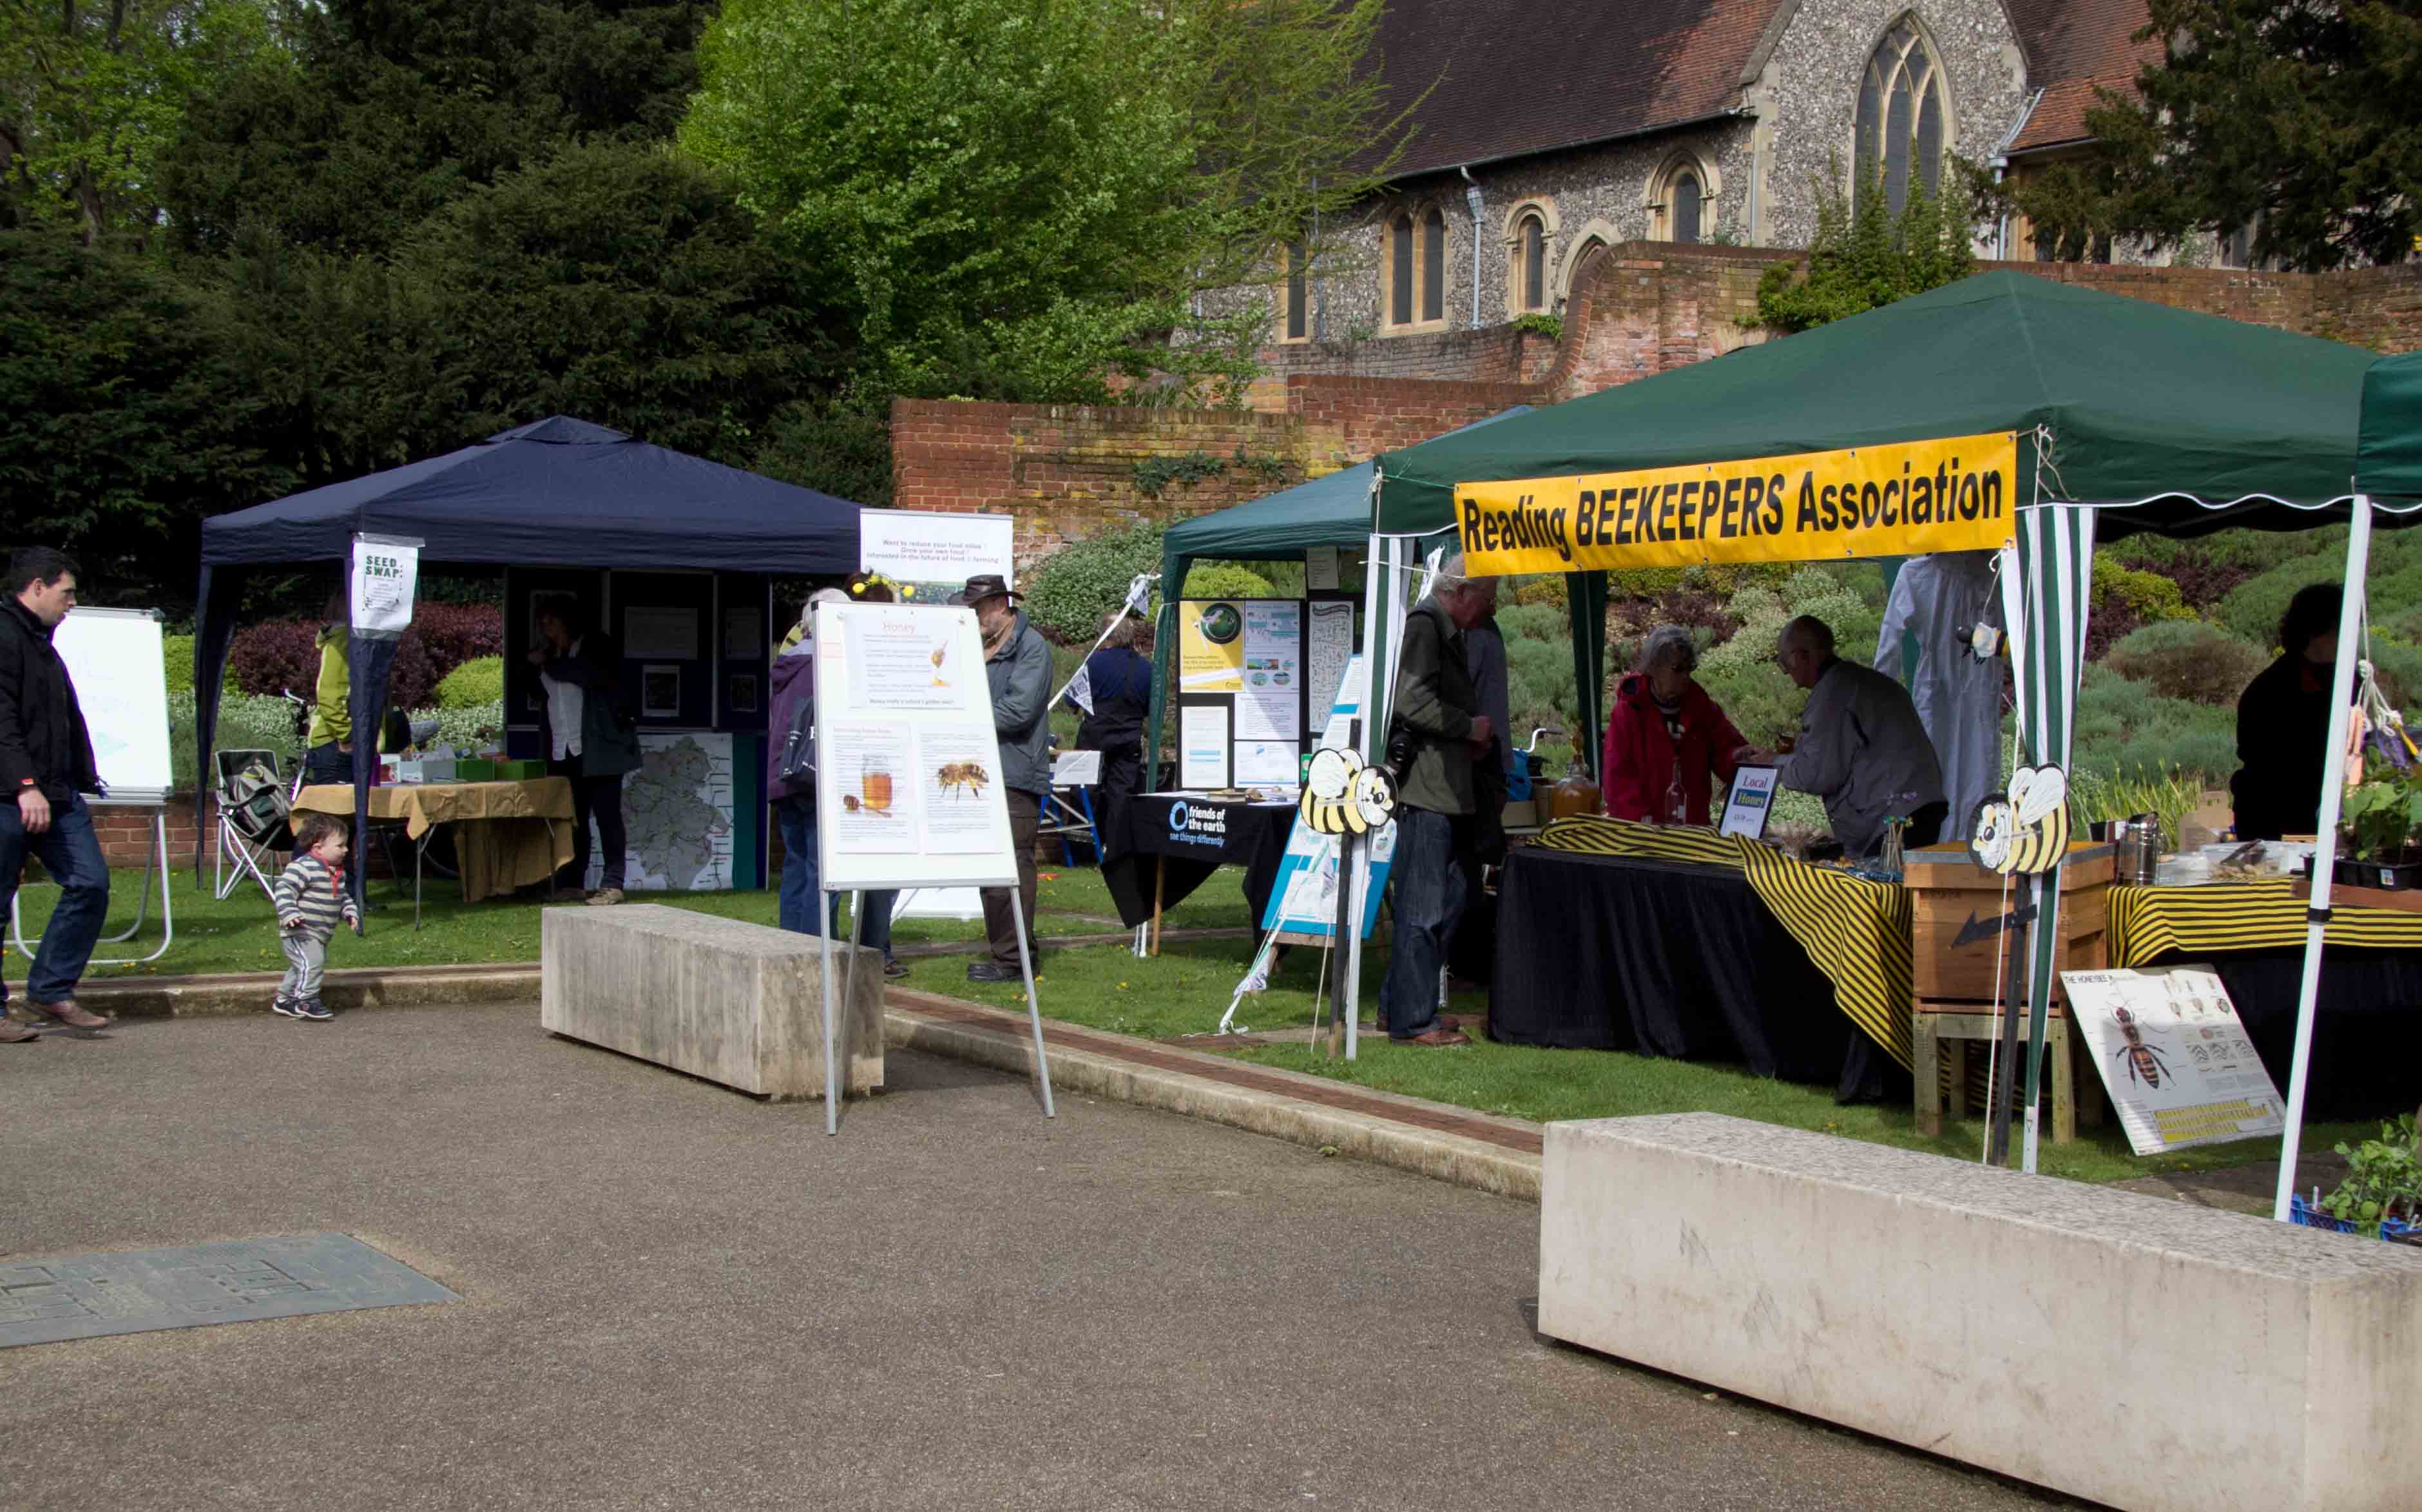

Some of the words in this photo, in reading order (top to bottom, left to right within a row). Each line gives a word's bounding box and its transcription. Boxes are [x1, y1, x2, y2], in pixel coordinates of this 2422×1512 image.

[1463, 495, 1572, 561] Reading
[1577, 473, 1784, 546] BEEKEEPERS
[1796, 457, 2003, 532] Association
[365, 555, 397, 568] SEED
[365, 566, 399, 578] SWAP
[882, 622, 916, 634] Honey
[1742, 774, 1769, 789] Local
[1737, 792, 1764, 809] Honey
[1189, 805, 1216, 820] friends
[1216, 809, 1226, 821] of
[1188, 818, 1202, 830] the
[1203, 821, 1226, 834] earth
[1180, 832, 1197, 845] things
[1197, 834, 1225, 848] differently
